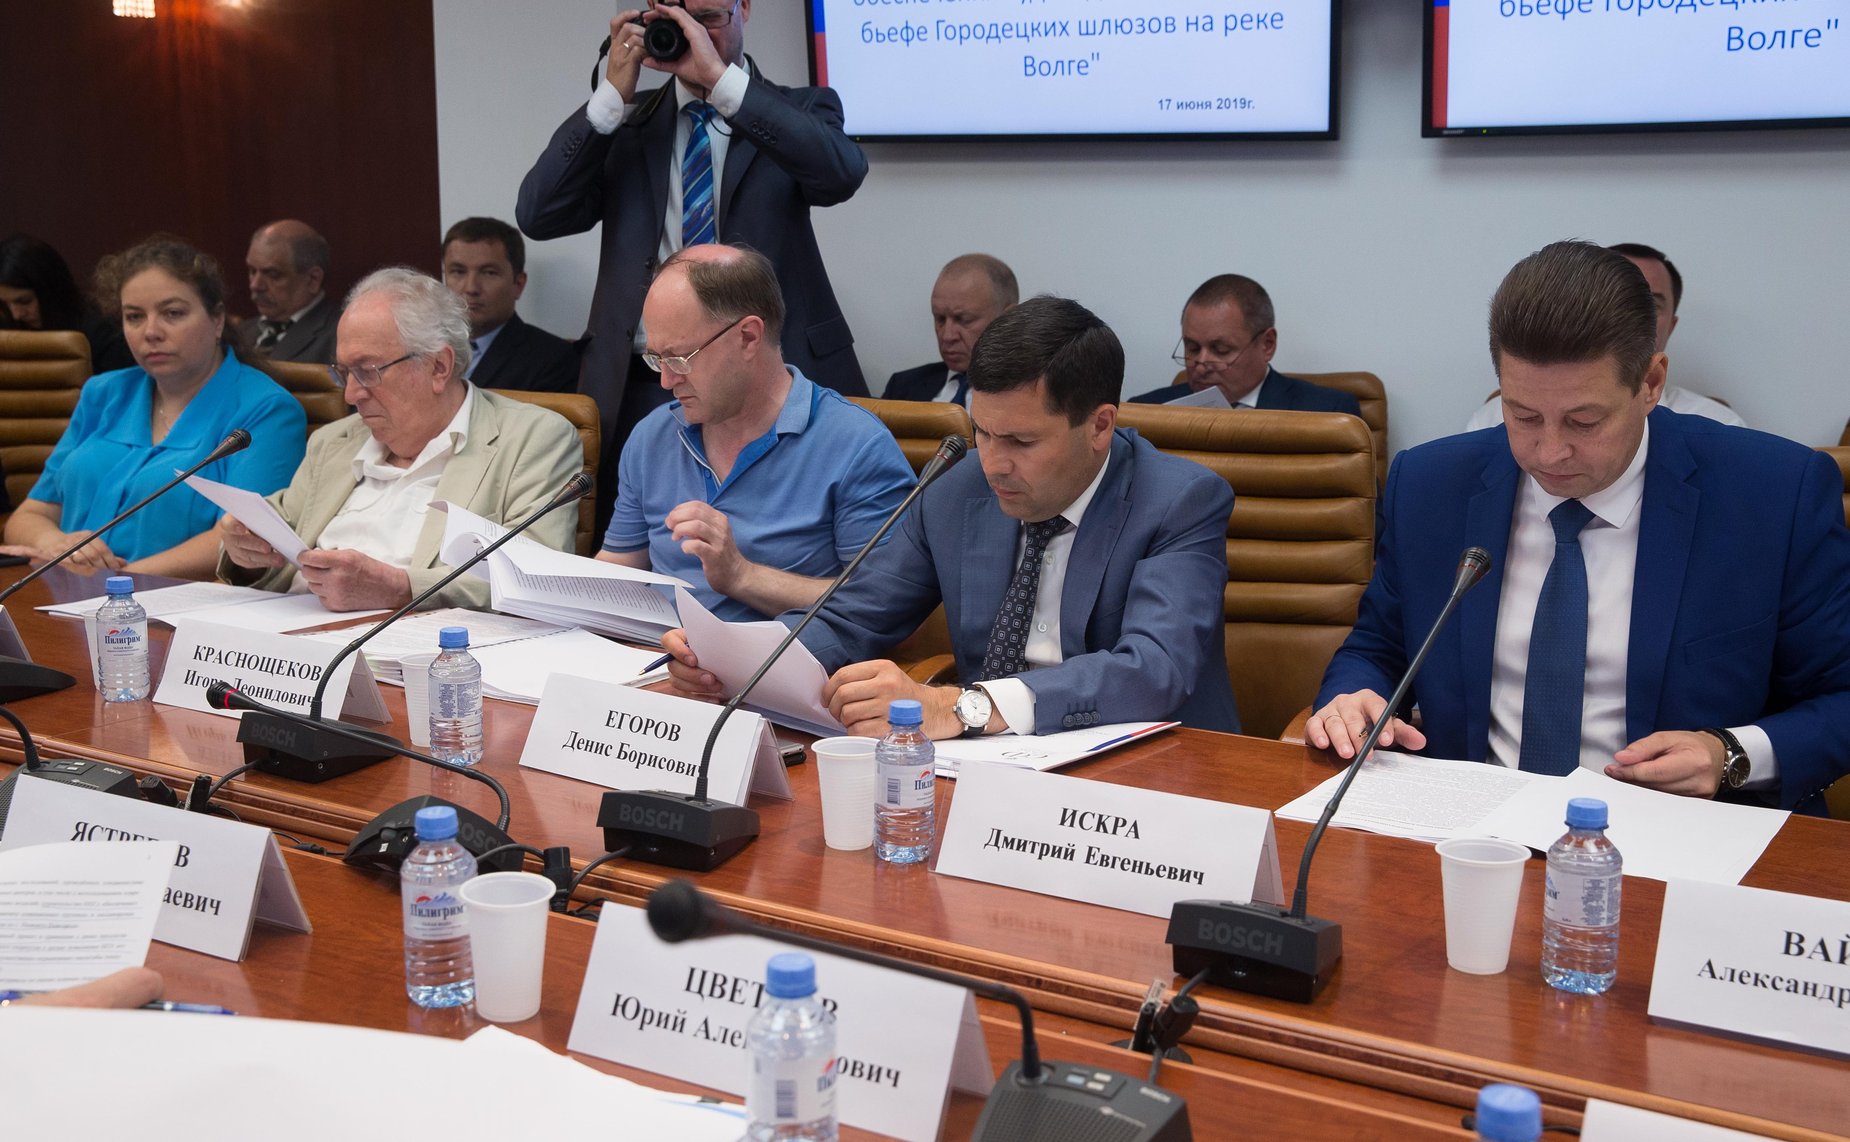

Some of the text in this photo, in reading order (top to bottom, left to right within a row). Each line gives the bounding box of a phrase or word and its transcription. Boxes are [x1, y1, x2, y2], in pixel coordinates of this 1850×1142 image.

[861, 11, 1284, 47] бьефе Городецких шлюзов на реке
[1727, 18, 1839, 52] Волге"
[1023, 52, 1100, 77] Волге"
[1158, 97, 1256, 111] 17 июня 2019г.
[105, 635, 142, 646] Пилигрим
[184, 669, 224, 689] Иго
[193, 644, 322, 682] КРАСНОЩЕКОВ
[251, 721, 298, 749] BOSCH
[604, 709, 682, 742] ЕГОРОВ
[562, 730, 702, 777] Денис Борисови
[620, 803, 685, 832] BOSCH
[1058, 807, 1141, 839] ИСКРА
[461, 822, 507, 864] OSC
[983, 827, 1205, 886] Дмитрий Евгеньевич
[410, 903, 465, 920] Пилигрим
[1198, 918, 1284, 956] BOSCH
[683, 966, 839, 1023] ЦВЕТВ
[610, 992, 688, 1034] Юрий
